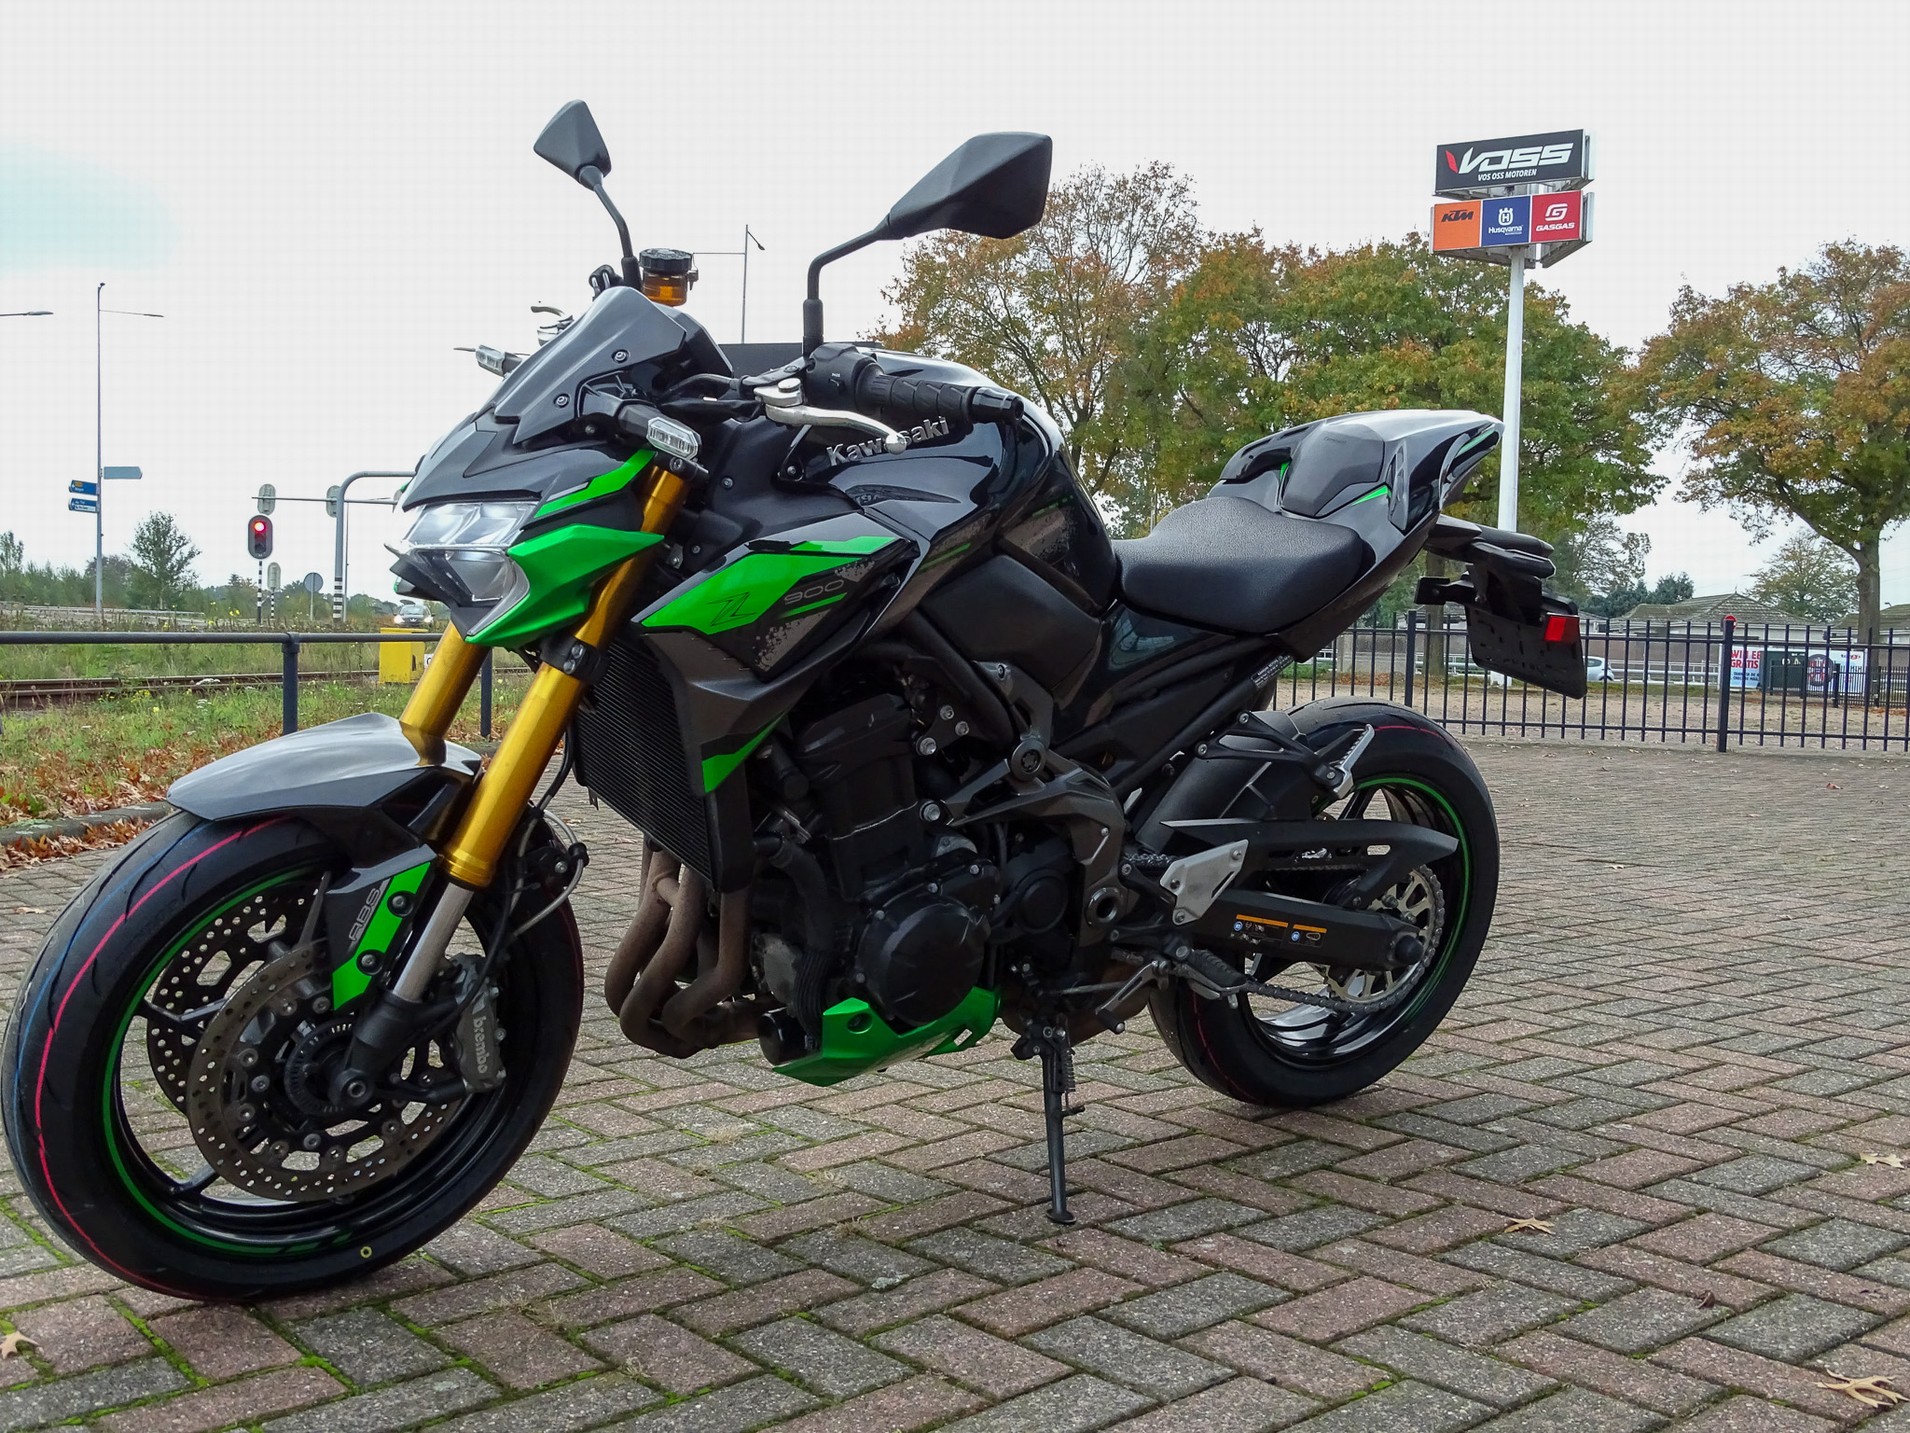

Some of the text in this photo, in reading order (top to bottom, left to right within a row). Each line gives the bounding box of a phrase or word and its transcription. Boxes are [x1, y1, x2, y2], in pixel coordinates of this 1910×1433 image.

[1445, 142, 1574, 174] VOSS
[1477, 168, 1537, 181] VOS OSS MOTOREN
[1441, 209, 1474, 223] KTM
[1488, 225, 1523, 234] Husqvarna
[1535, 222, 1575, 232] GASGAS
[826, 415, 950, 467] Kawsaki
[784, 579, 845, 605] 900
[1731, 659, 1759, 669] GRTIS
[348, 887, 381, 941] ABS
[473, 1015, 490, 1074] brembo
